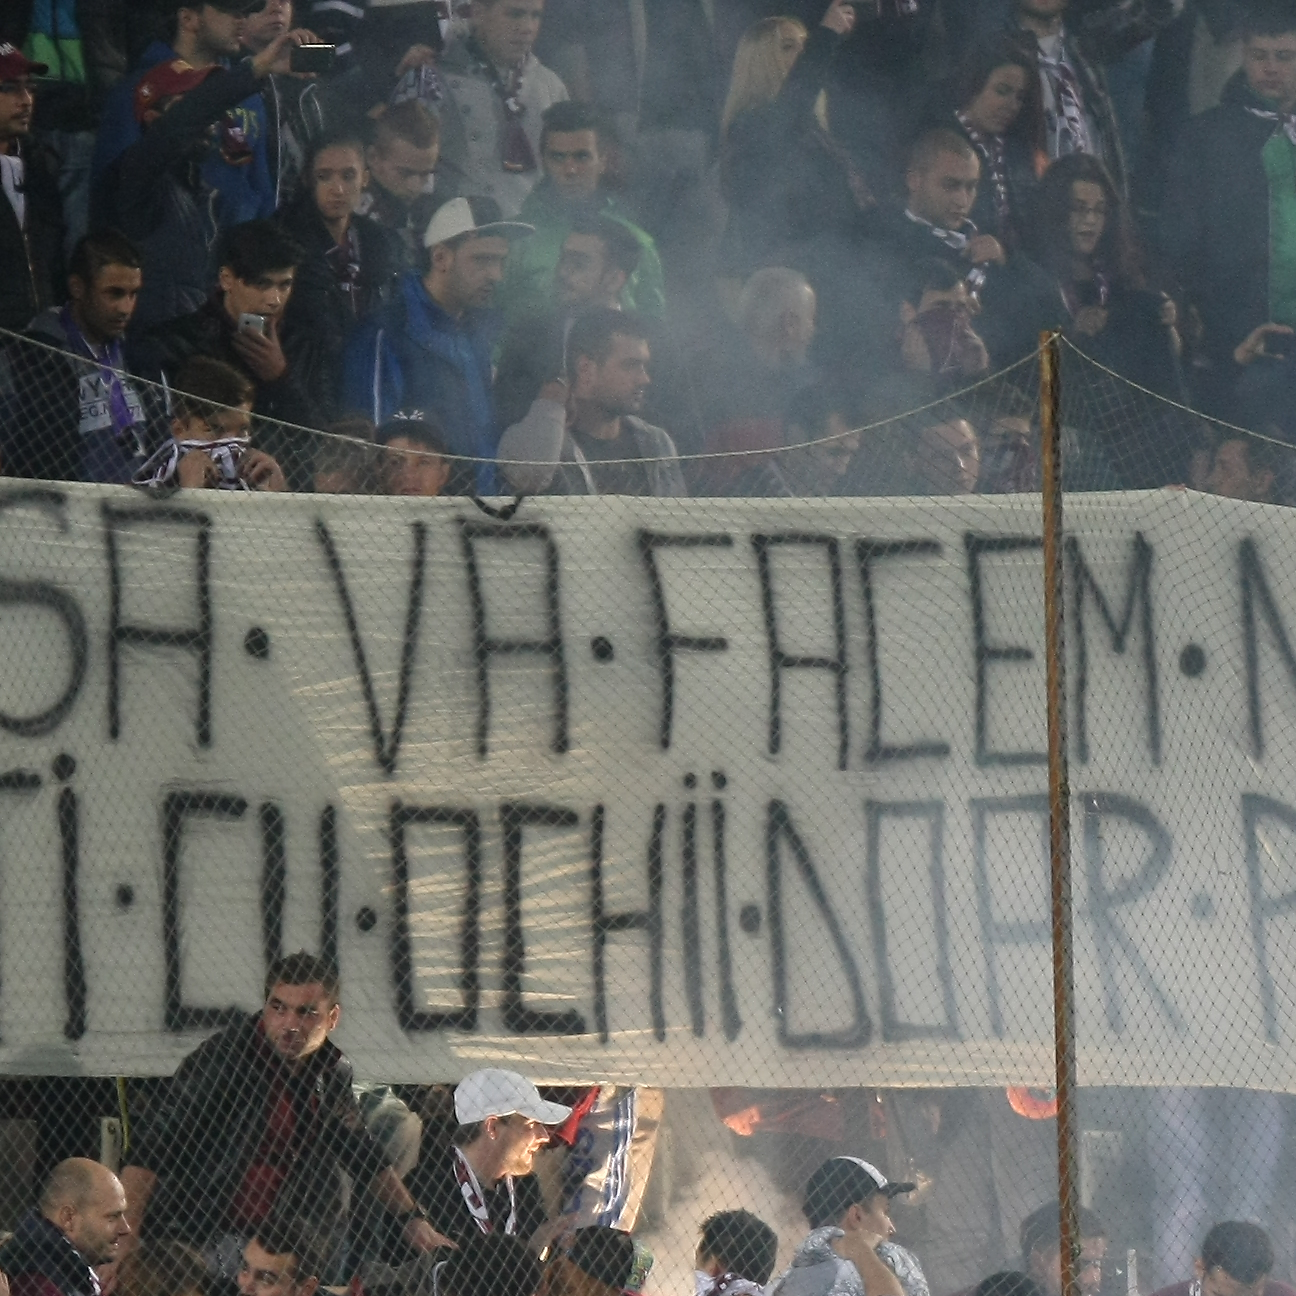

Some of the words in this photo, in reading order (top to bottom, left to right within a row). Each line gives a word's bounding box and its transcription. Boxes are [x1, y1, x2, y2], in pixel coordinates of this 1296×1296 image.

[636, 528, 1164, 771] FACEM
[160, 790, 340, 1032] CU
[390, 770, 744, 1044] OCHII
[764, 790, 1190, 1051] DOAR
